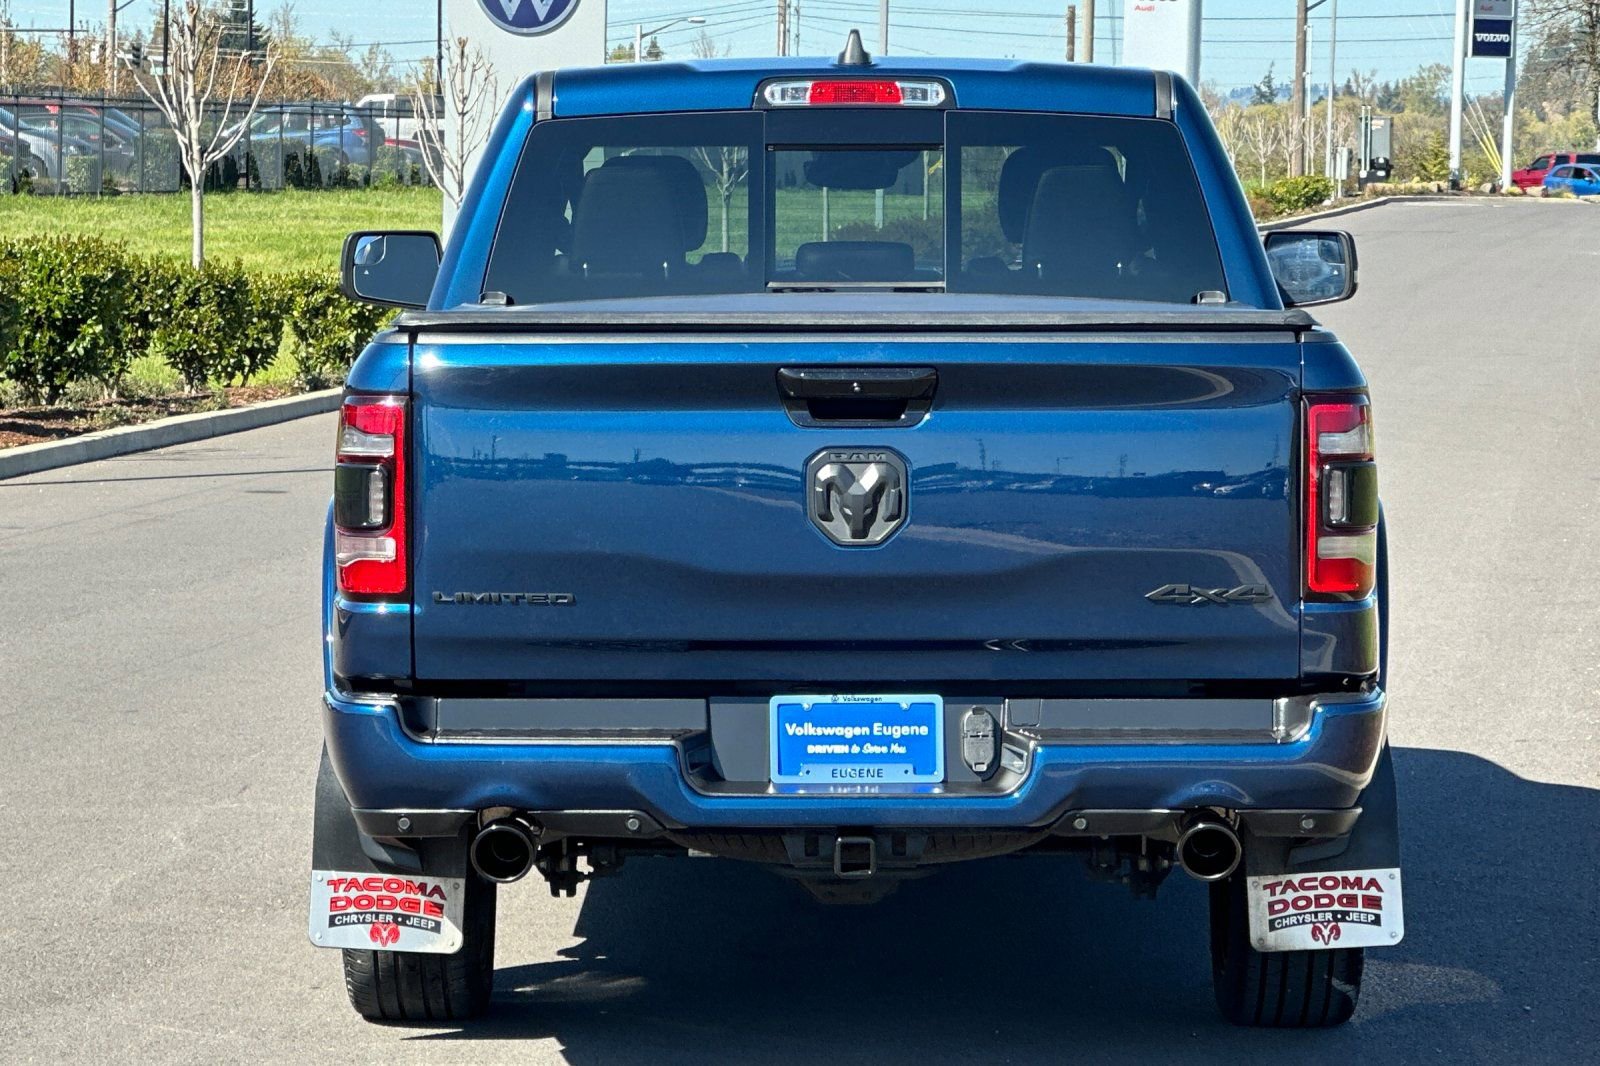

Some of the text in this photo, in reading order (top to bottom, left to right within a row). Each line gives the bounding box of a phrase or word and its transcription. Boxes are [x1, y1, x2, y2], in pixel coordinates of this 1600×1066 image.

[1474, 33, 1511, 43] VOLVO
[829, 452, 887, 461] RAM
[432, 591, 576, 606] LIMITED
[842, 695, 883, 703] Volkswagen
[785, 722, 929, 739] Volkswagen Eugene
[807, 744, 849, 754] DRIVEN
[851, 743, 861, 754] to
[831, 768, 884, 778] EUGENE
[327, 877, 447, 900] TACOMA
[1262, 876, 1384, 897] TACOMA
[329, 894, 445, 918] DODGE
[1267, 893, 1383, 917] DODGE
[334, 914, 436, 929] CHRYSLER JEEP
[1274, 912, 1376, 928] CHRYSLER JEEP
